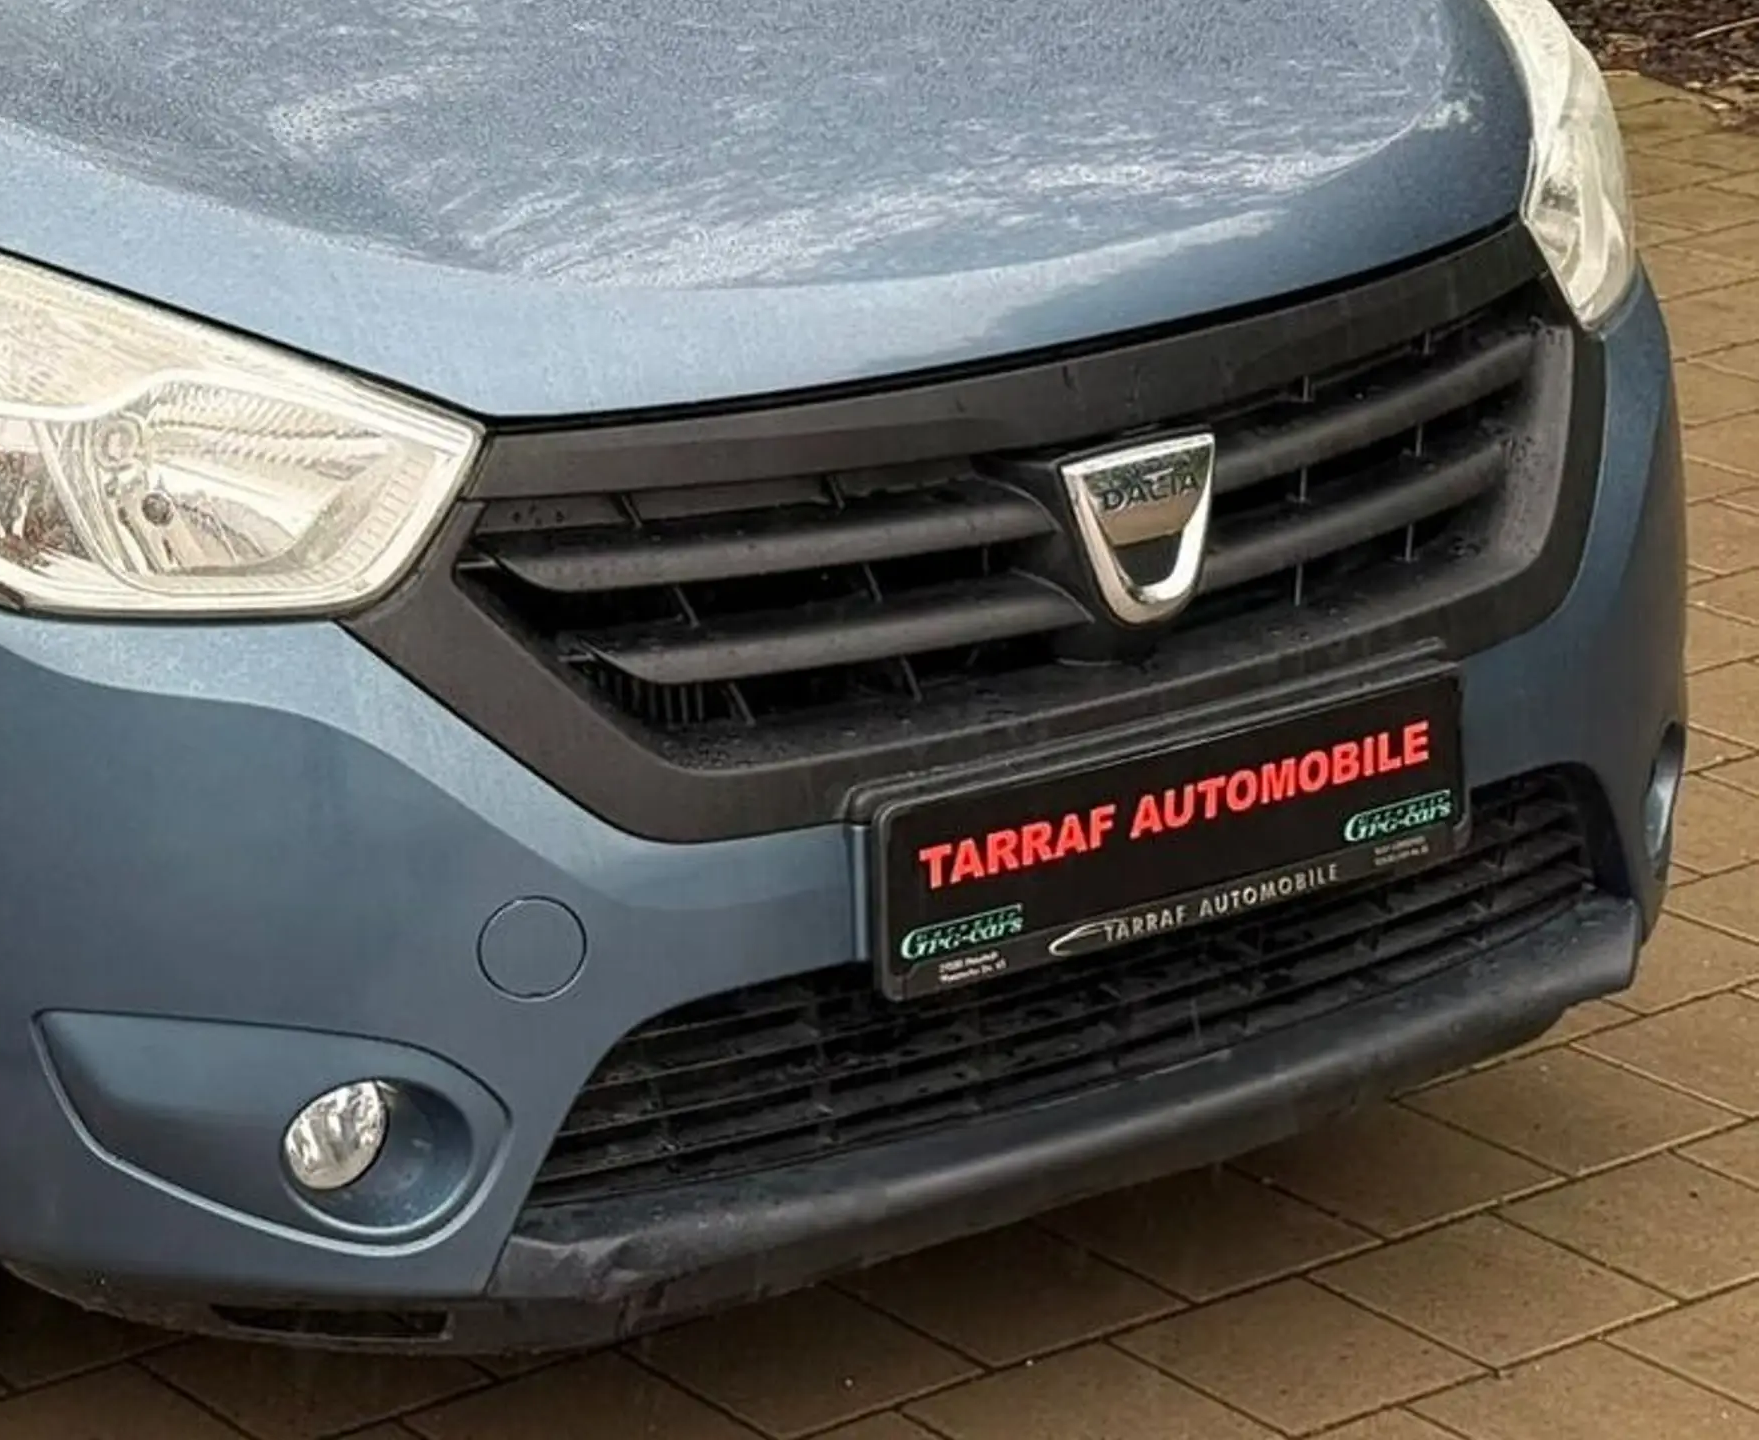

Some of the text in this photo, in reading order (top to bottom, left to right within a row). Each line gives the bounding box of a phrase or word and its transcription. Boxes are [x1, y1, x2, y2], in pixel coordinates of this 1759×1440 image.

[919, 721, 1429, 891] TARRAF AUTOMOBILE
[1103, 863, 1339, 942] TARRAF AUTOMOBILE
